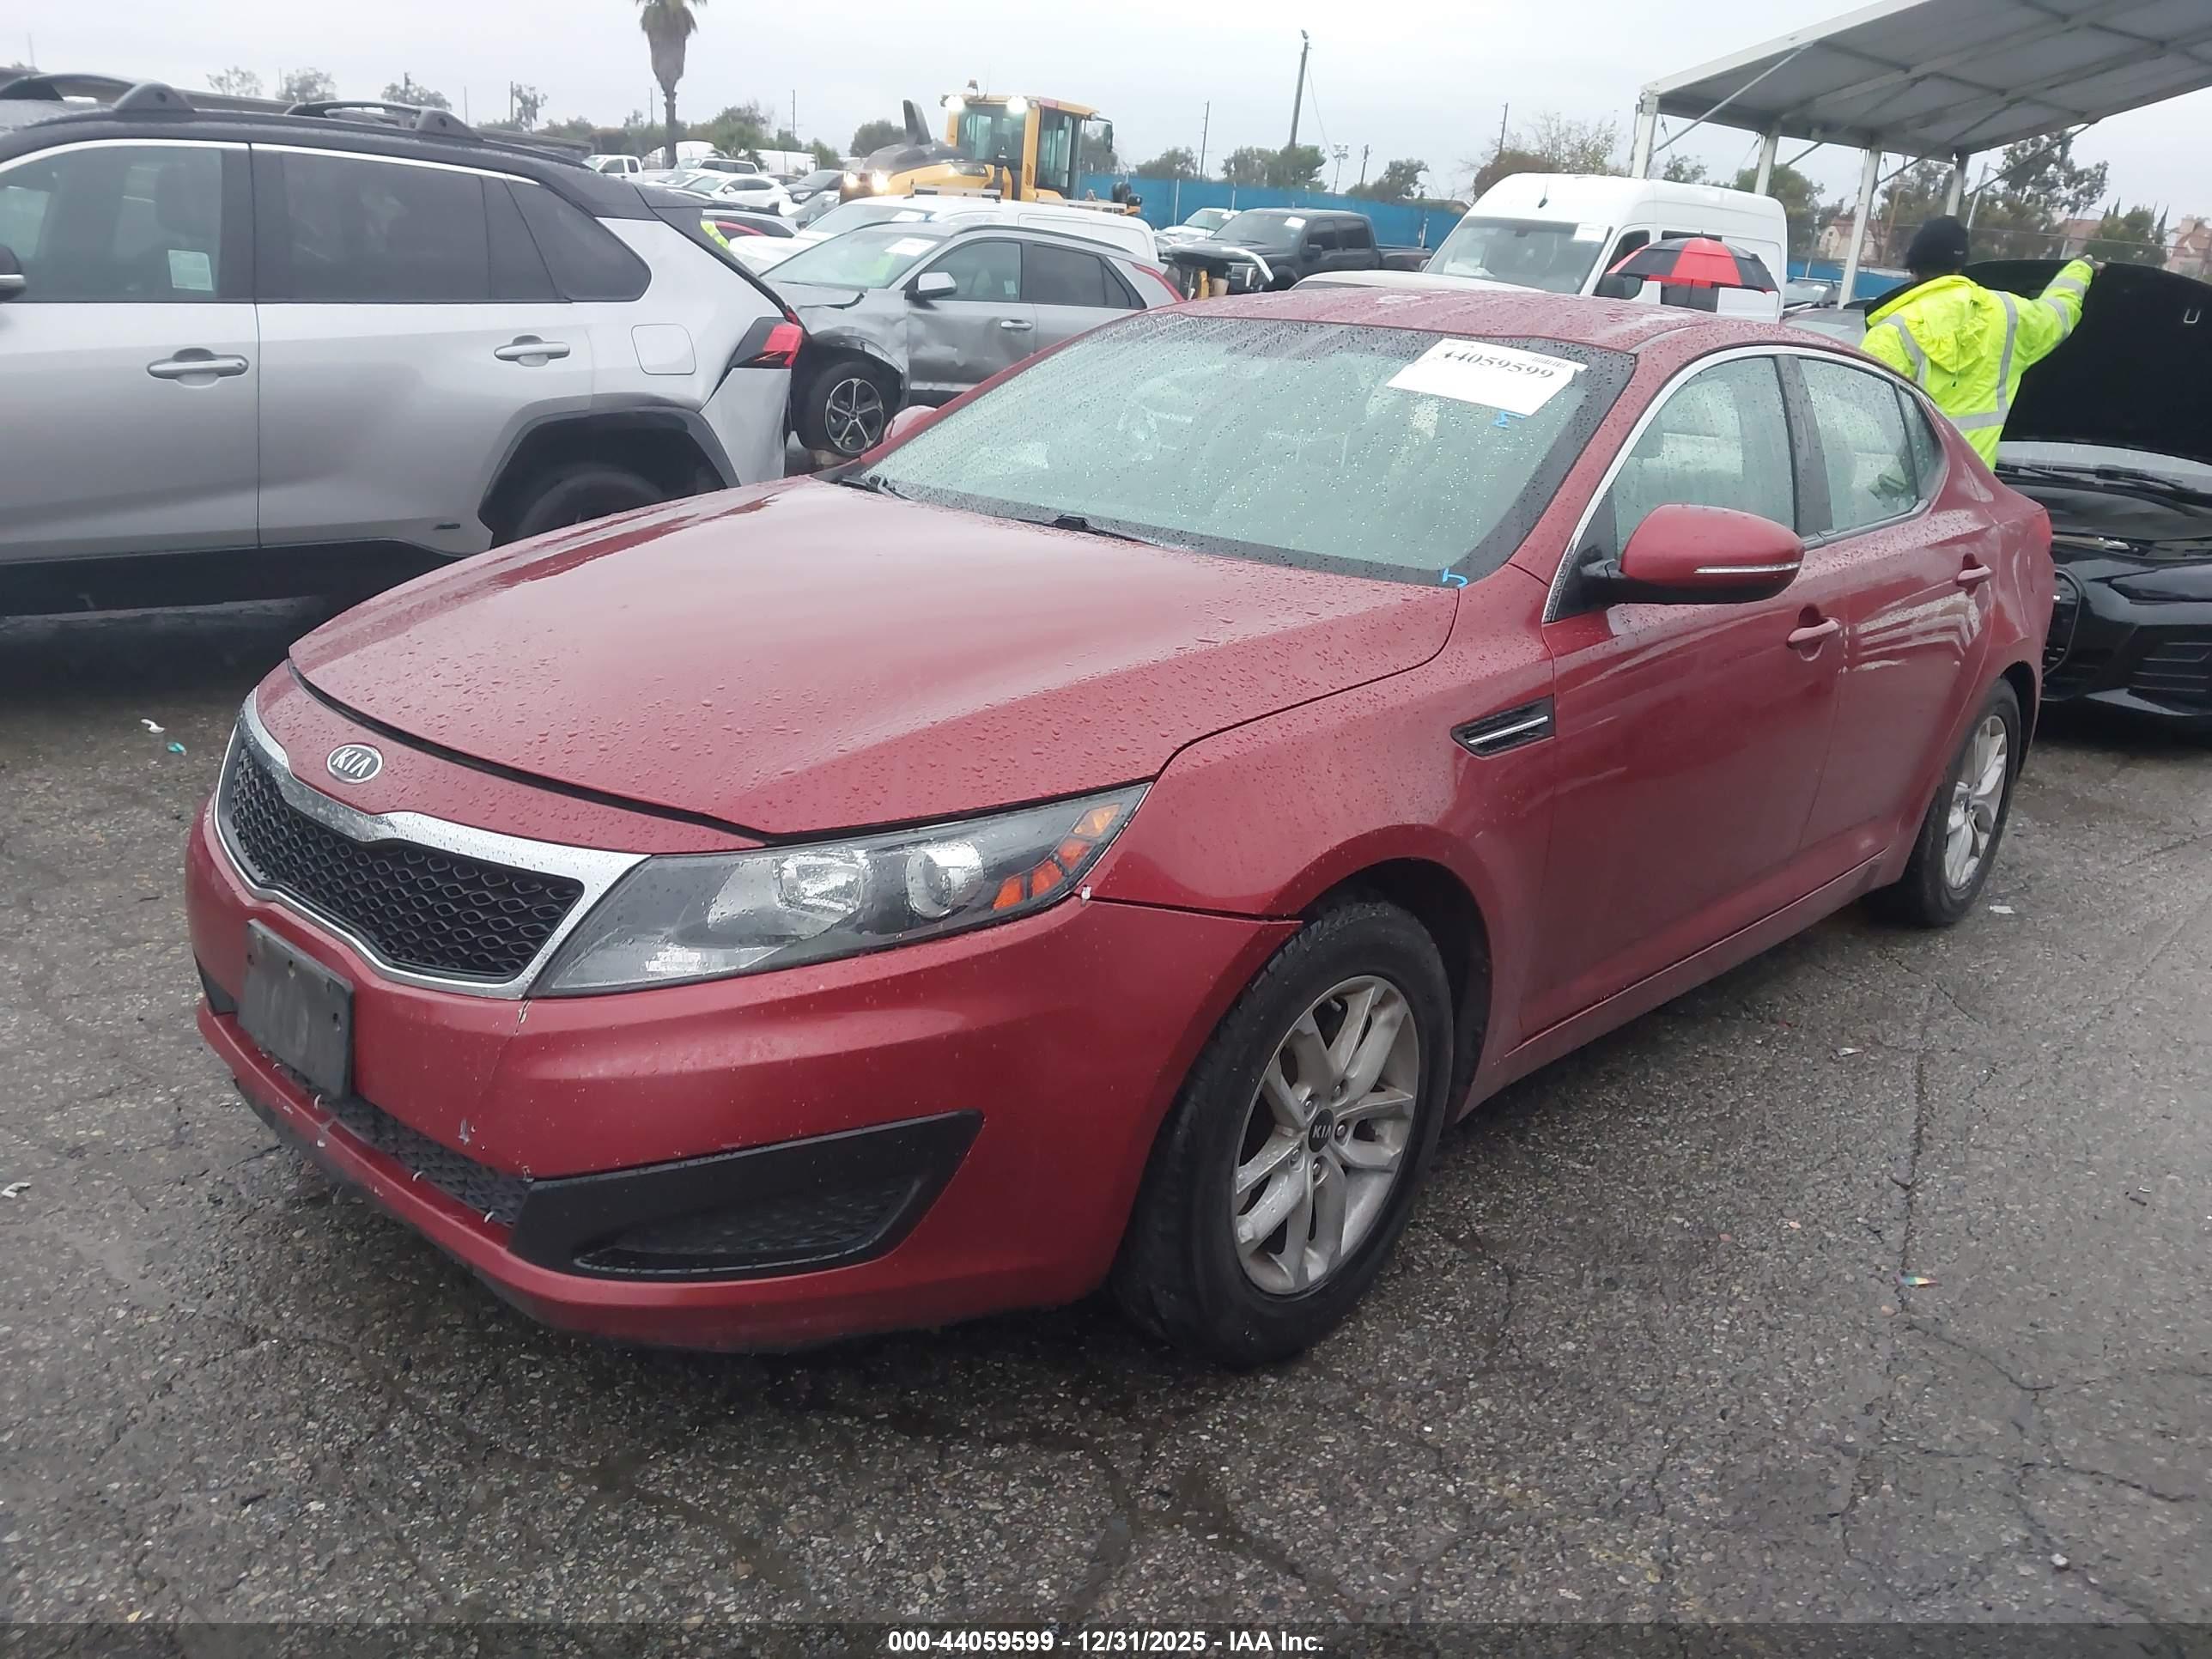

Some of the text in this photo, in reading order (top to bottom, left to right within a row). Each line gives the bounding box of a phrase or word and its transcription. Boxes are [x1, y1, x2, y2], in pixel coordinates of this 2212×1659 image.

[1442, 349, 1555, 379] 44059599
[331, 748, 373, 778] KIA
[1311, 1124, 1332, 1139] KIA
